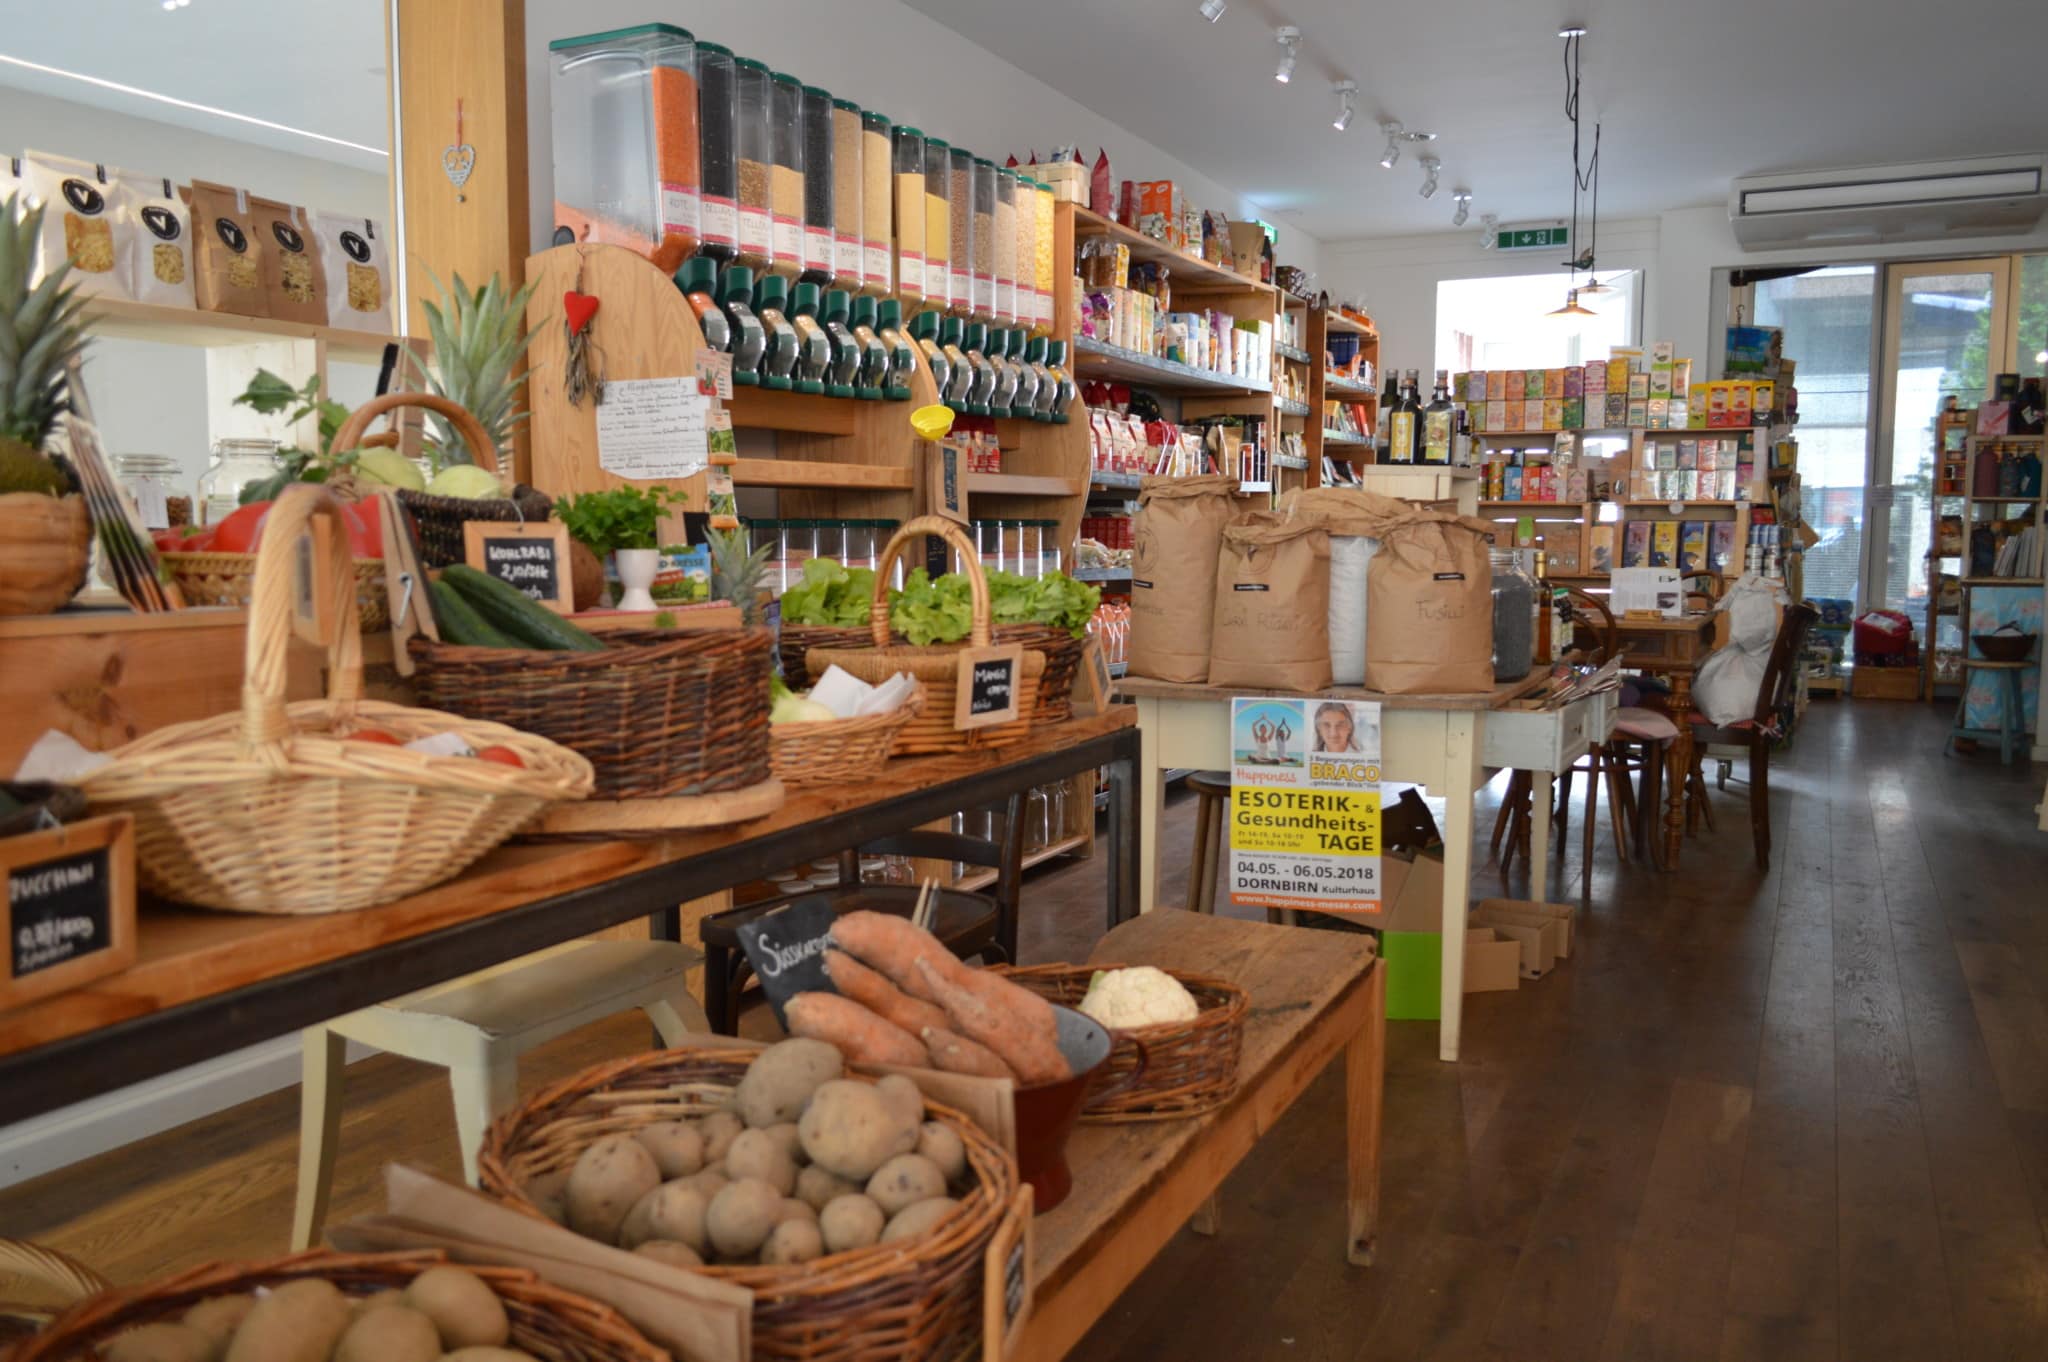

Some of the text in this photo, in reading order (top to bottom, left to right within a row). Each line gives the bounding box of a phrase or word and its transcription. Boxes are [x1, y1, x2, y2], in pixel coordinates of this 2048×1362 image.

[488, 545, 551, 560] KOHLRABI
[1309, 762, 1380, 782] BRACO
[1239, 791, 1375, 814] ESOTERIK- &
[1237, 811, 1374, 832] Gesundheits-
[1317, 833, 1374, 851] TAGE
[1238, 862, 1281, 875] 04.05.
[1293, 865, 1374, 880] 06.05.2018
[1238, 877, 1376, 895] DORNBIRN Kulturhaus
